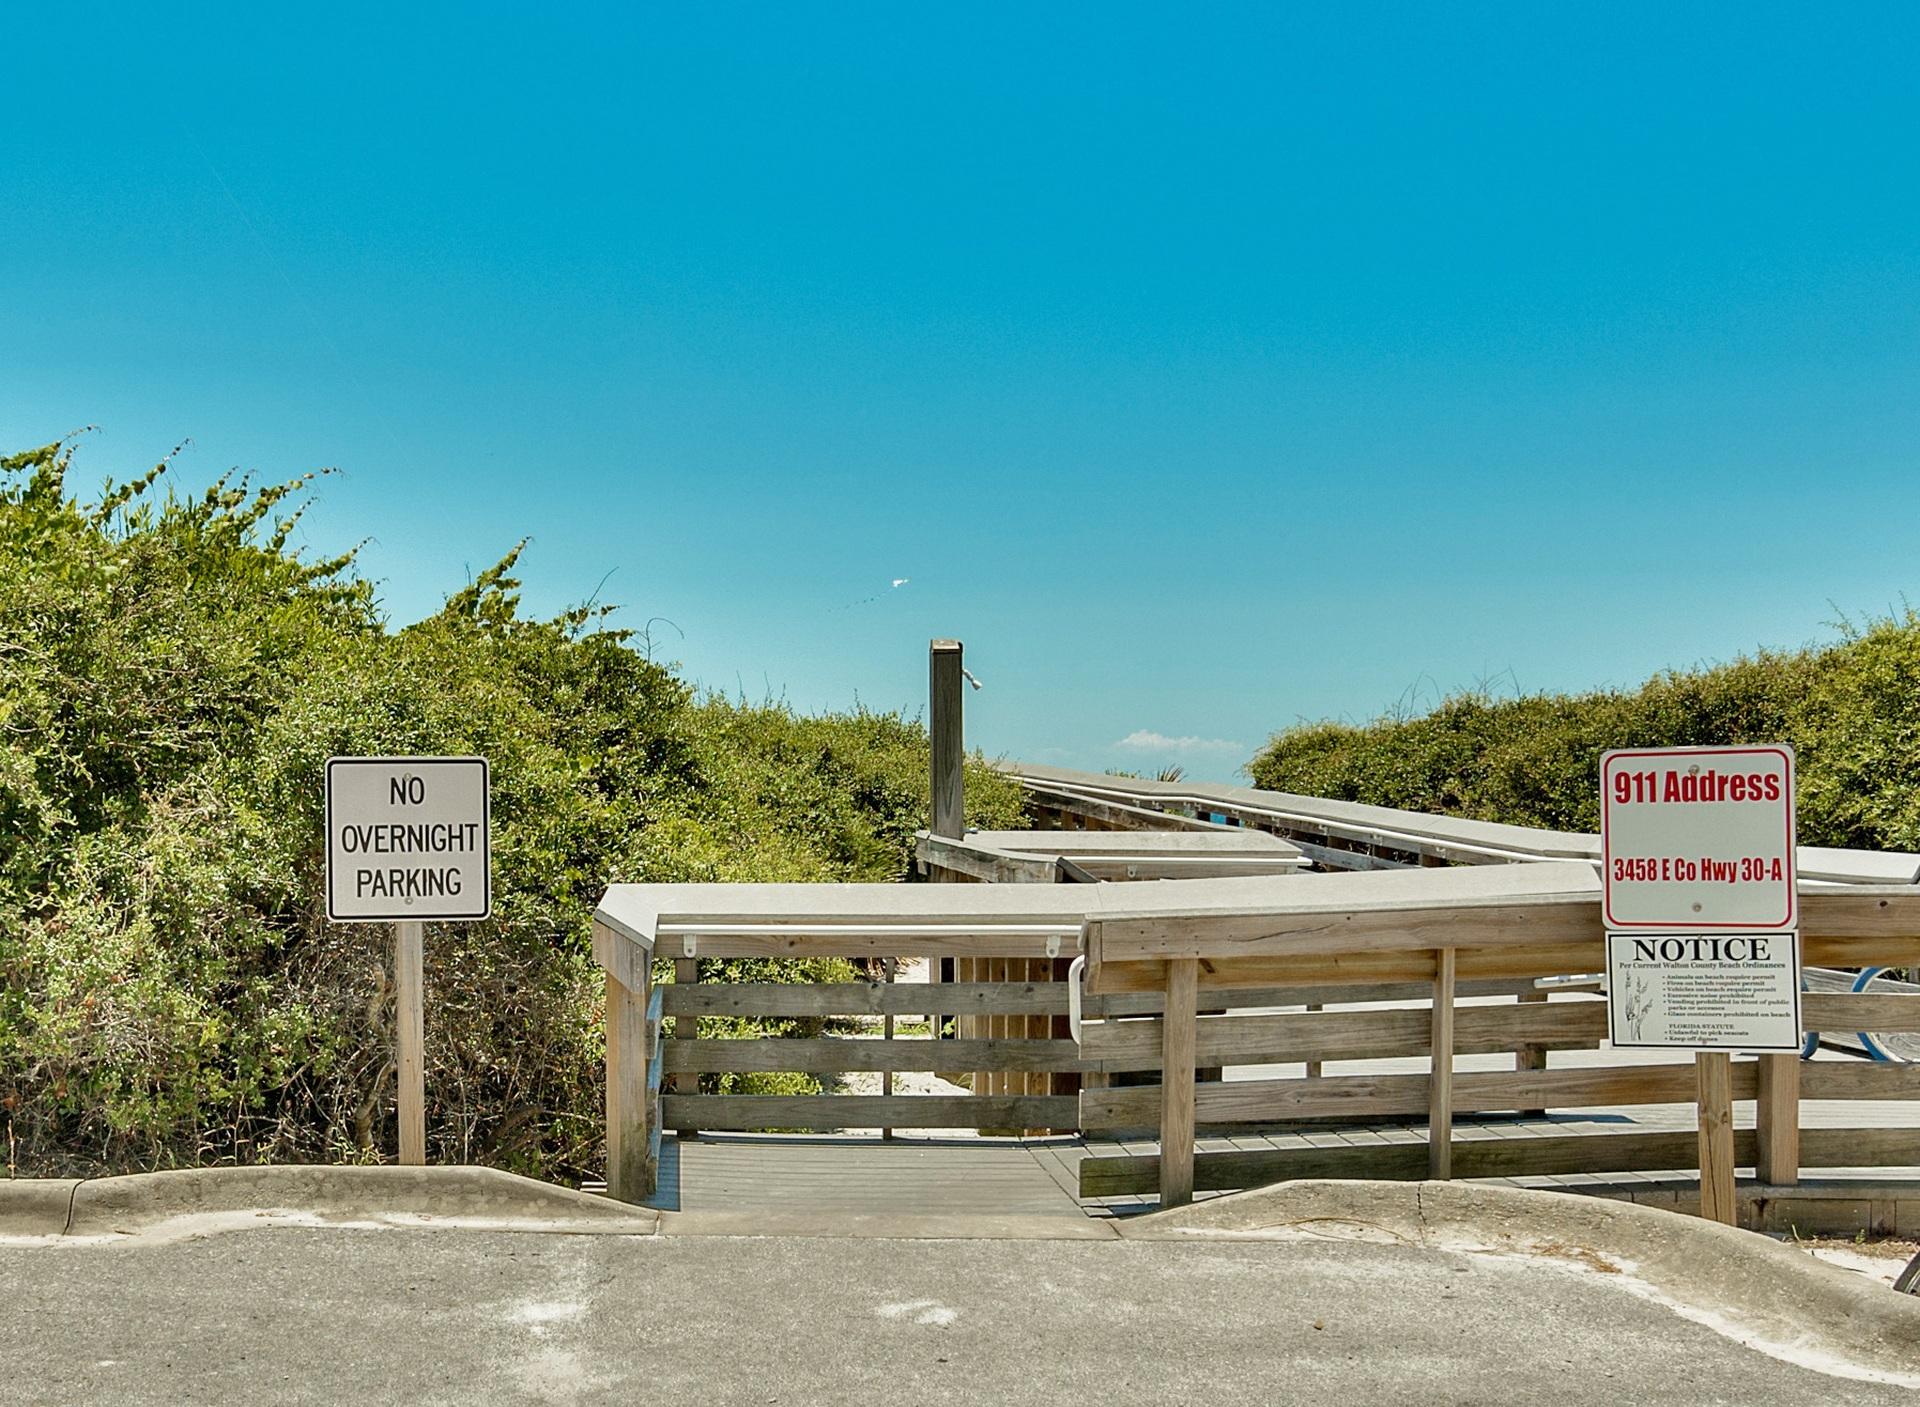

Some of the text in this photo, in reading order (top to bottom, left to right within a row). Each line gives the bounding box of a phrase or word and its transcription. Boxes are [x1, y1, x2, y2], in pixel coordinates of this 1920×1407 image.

[390, 777, 425, 805] NO
[1615, 770, 1780, 803] 911 Address
[342, 824, 478, 853] OVERNIGHT
[356, 868, 462, 898] PARKING
[1614, 858, 1782, 884] 3458 E Co Hwy 30-A
[1632, 938, 1771, 961] NOTICE
[1690, 962, 1717, 970] County
